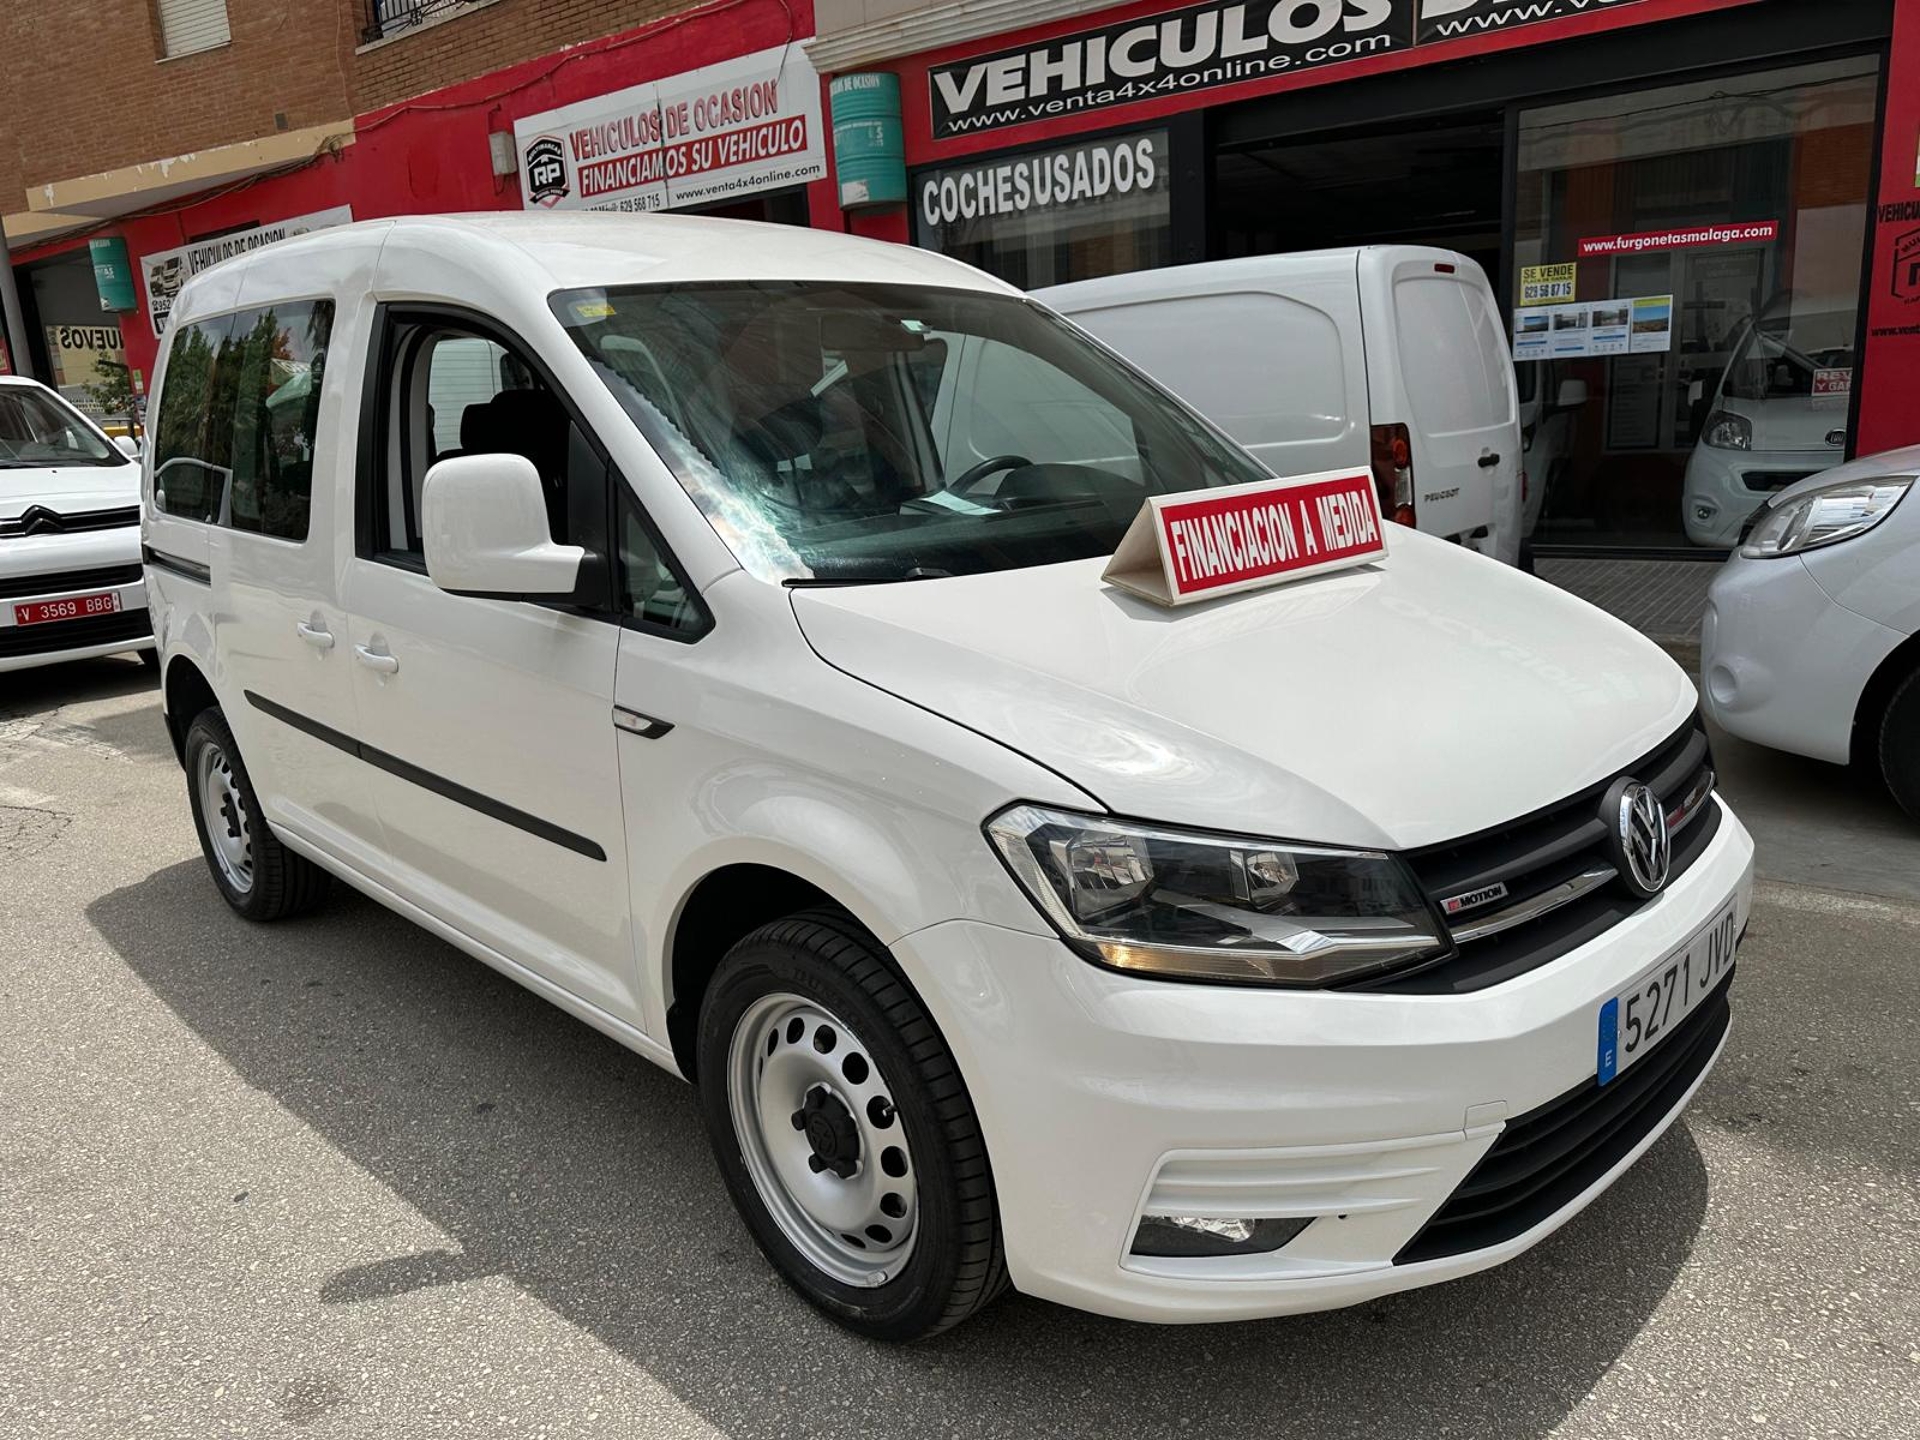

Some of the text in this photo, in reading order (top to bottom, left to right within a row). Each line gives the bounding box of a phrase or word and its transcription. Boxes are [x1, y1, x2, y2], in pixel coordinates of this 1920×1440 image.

[934, 0, 1392, 115] VEHICULOS
[948, 33, 1392, 132] www.venta4x4online.com
[569, 79, 778, 162] VEHICULOS DE OCASION
[533, 162, 561, 187] RP
[582, 145, 687, 195] FINANCIAMOS
[691, 137, 713, 169] SU
[717, 120, 804, 164] VEHICULO
[647, 193, 660, 208] 715
[676, 163, 820, 201] www.venta4x4online.com
[1584, 223, 1773, 254] www.furgonetasmalaga.com
[1523, 264, 1574, 279] SE VENDE
[1170, 489, 1378, 582] FINANCIACION A MEDIDA
[21, 607, 30, 621] V
[40, 602, 77, 619] 3569
[86, 597, 112, 613] BBG
[1625, 914, 1735, 1053] 5271 JVD
[1604, 1052, 1612, 1067] E
